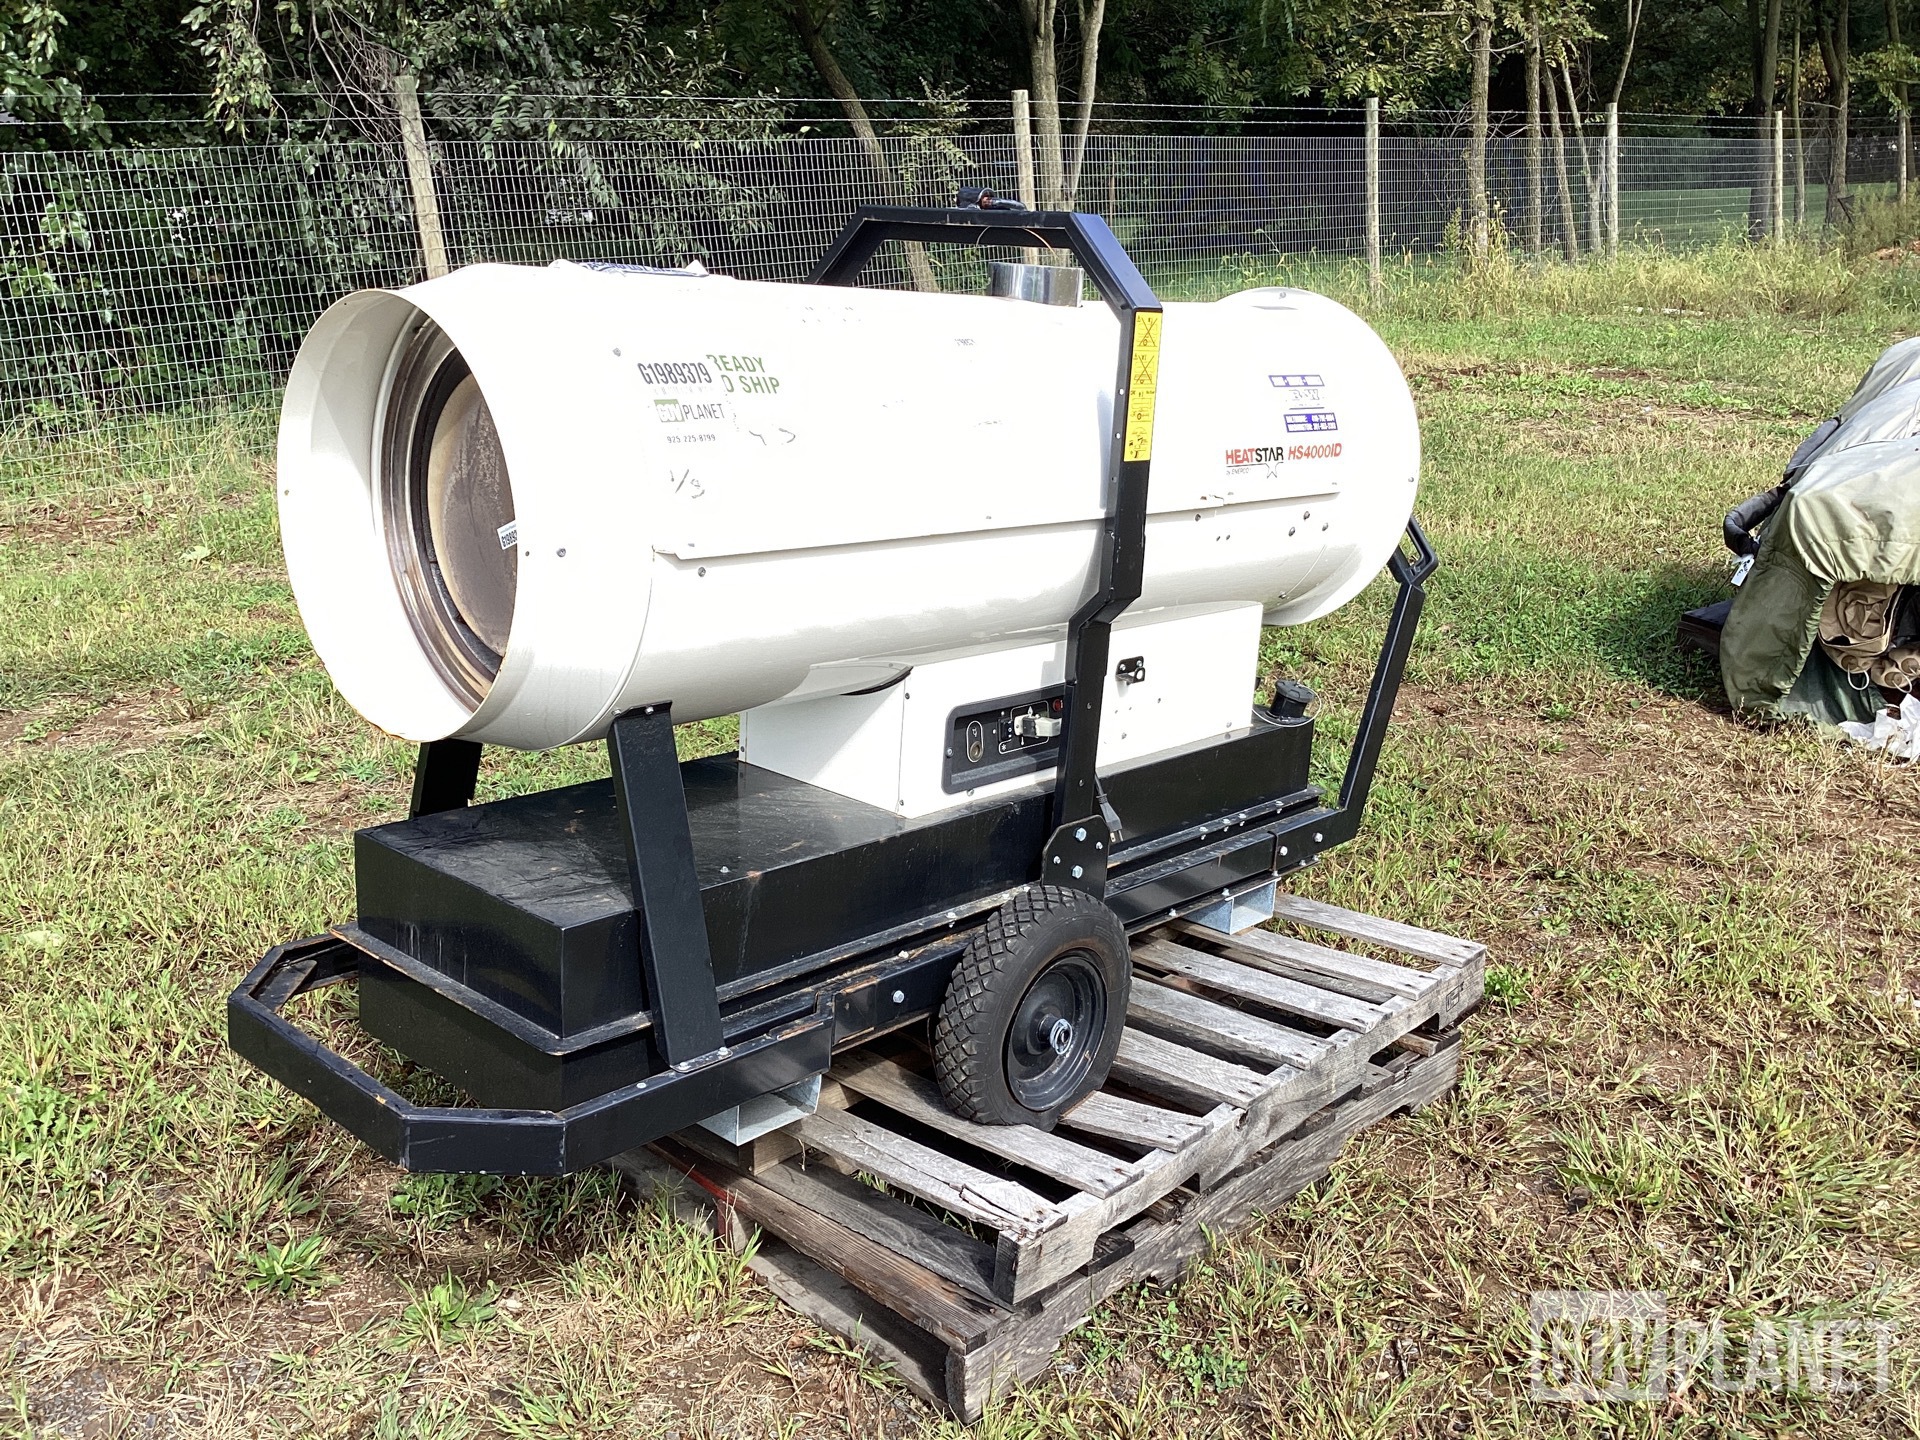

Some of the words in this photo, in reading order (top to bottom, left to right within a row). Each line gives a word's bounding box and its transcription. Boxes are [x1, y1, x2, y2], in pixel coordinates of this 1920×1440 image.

[637, 361, 712, 385] G1989379
[738, 375, 781, 395] SHIP
[1225, 446, 1285, 465] HEATSTAR
[1288, 442, 1343, 461] HS4000ID
